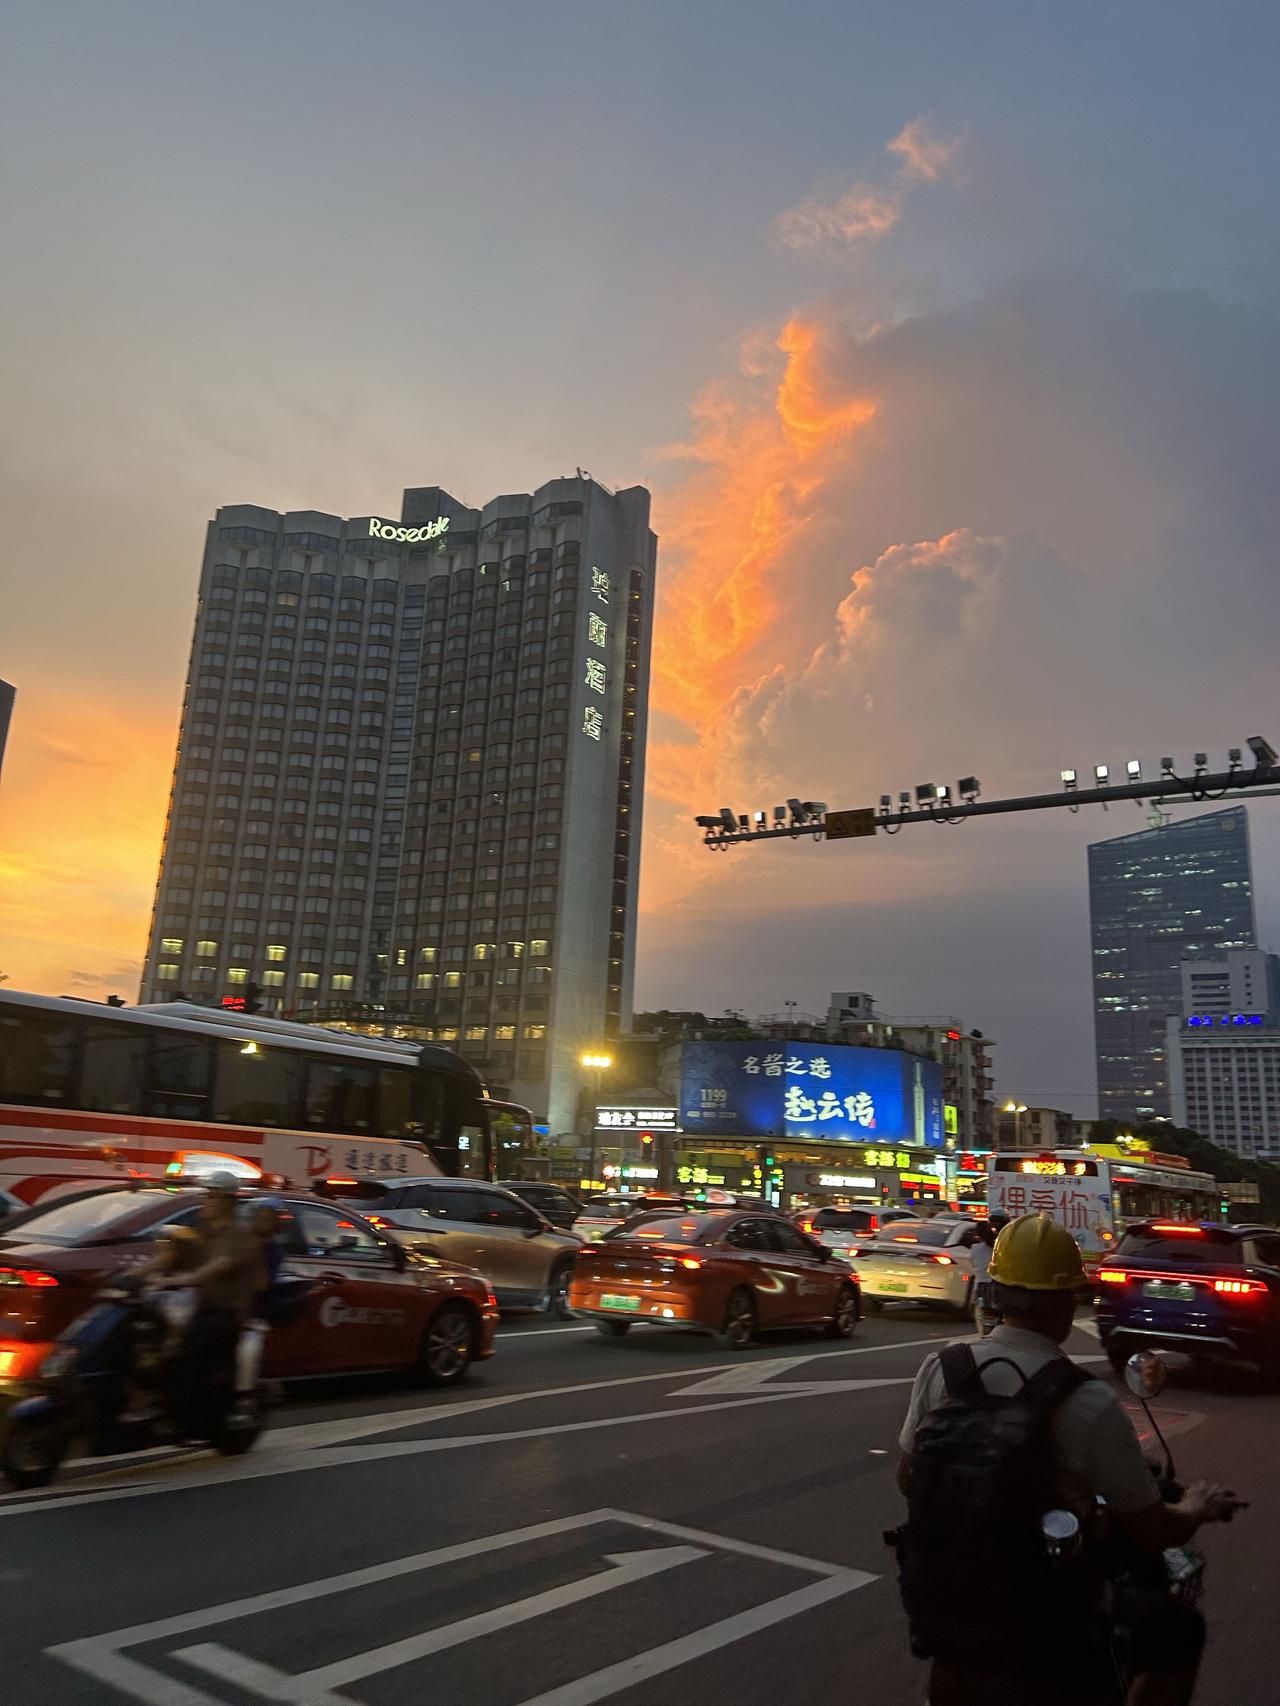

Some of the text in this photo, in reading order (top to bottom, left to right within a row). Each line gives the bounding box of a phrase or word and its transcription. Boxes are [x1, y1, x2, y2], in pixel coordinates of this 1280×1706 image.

[368, 515, 450, 543] Rosedale
[700, 1088, 728, 1102] 1199
[783, 1085, 876, 1127] 赵云传
